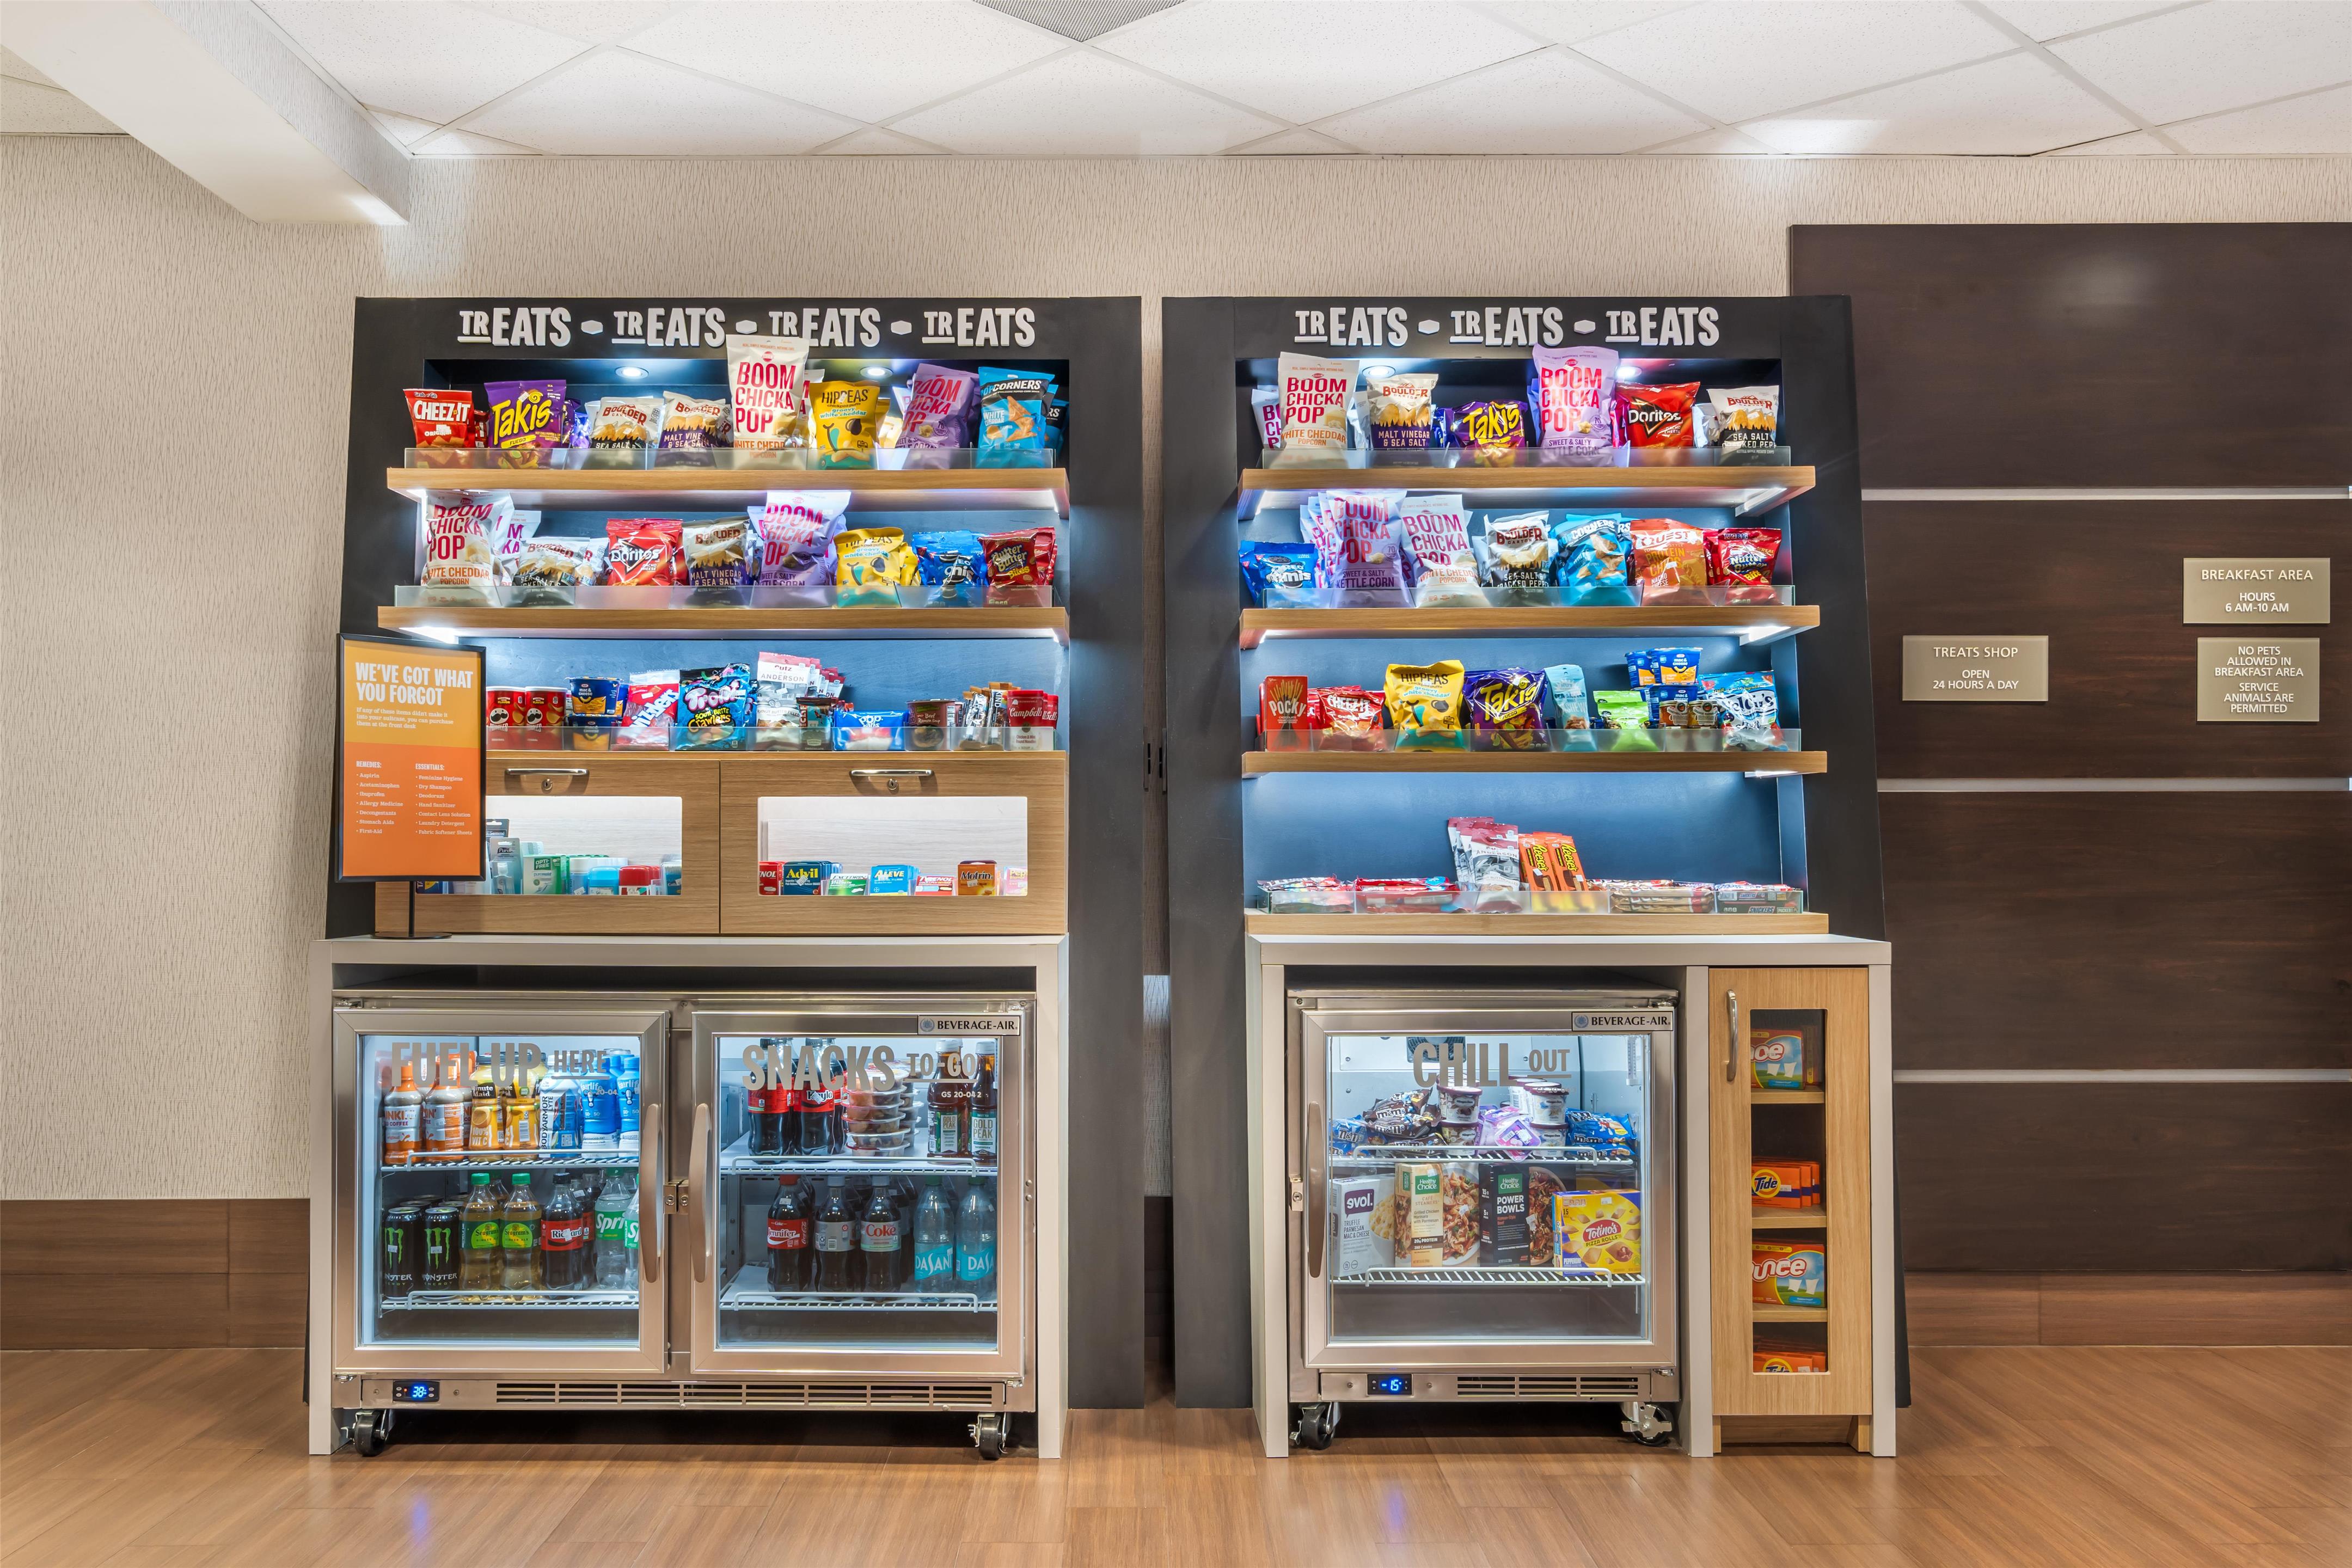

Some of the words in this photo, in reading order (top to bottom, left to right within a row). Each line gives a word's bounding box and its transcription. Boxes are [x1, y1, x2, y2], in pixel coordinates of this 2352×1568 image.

[458, 307, 571, 346] TREATS
[612, 307, 725, 347] TREATS
[769, 308, 881, 347] TREATS
[924, 308, 1035, 347] TREATS
[1295, 307, 1408, 346] TREATS
[1450, 307, 1563, 346] TREATS
[1606, 307, 1719, 346] TREATS
[737, 362, 797, 389] BOOM
[1287, 377, 1346, 393] BOOM
[736, 387, 794, 410] CHICKA
[1287, 393, 1343, 408] CHICKA
[1728, 397, 1772, 410] BOULDER
[736, 408, 773, 433] POP
[983, 410, 1004, 419] WHITE
[1285, 406, 1324, 425] POP
[491, 400, 552, 445] Takis
[984, 417, 1004, 426] CHEDDAR
[510, 437, 526, 445] FUEGO
[1282, 430, 1304, 440] WHITE
[1307, 429, 1346, 444] CHEDDAR
[1402, 431, 1430, 439] VINEGAR
[1334, 496, 1388, 522] BOOM
[1336, 519, 1390, 540] CHICKA
[611, 548, 660, 562] Doritos
[1338, 538, 1372, 565] POP
[449, 567, 489, 580] CHEDDAR
[690, 571, 708, 580] MALT
[712, 570, 741, 579] VINEGAR
[2202, 569, 2274, 580] BREAKFAST
[2278, 570, 2313, 580] AREA
[1336, 577, 1367, 588] KETTLE
[1369, 577, 1394, 587] CORN
[2240, 592, 2275, 601] HOURS
[2226, 603, 2232, 612] 6
[2234, 603, 2268, 612] AM-10
[2271, 603, 2289, 612] AM
[1933, 647, 1979, 658] TREATS
[1984, 647, 2018, 658] SHOP
[2239, 646, 2254, 655] NO
[2258, 647, 2280, 655] PETS
[2227, 657, 2277, 666] ALLOWED
[2281, 657, 2291, 665] IN
[356, 662, 399, 683] WE'VE
[403, 666, 430, 685] GOT
[434, 668, 473, 689] WHAT
[1962, 670, 1989, 678] OPEN
[2215, 667, 2273, 676] BREAKFAST
[2276, 668, 2304, 676] AREA
[1933, 681, 1945, 689] 24
[1949, 681, 1983, 689] HOURS
[1987, 681, 1994, 689] A
[1998, 681, 2019, 689] DAY
[2239, 683, 2278, 691] SERVICE
[356, 682, 385, 702] YOU
[390, 685, 444, 706] FORGOT
[2224, 694, 2270, 702] ANIMALS
[2274, 694, 2294, 702] ARE
[2231, 704, 2287, 713] PERMITTED
[688, 714, 731, 732] Crawlers
[786, 868, 818, 878] Advil
[960, 871, 990, 880] Motrin
[937, 1020, 1016, 1030] BEVERAGE-AIR
[1591, 1016, 1669, 1026] BEVERAGE-AIR
[392, 1042, 477, 1088] FUEL
[491, 1043, 541, 1088] UP
[554, 1050, 607, 1073] HERE
[743, 1045, 895, 1091] SNACKS
[906, 1053, 976, 1077] TO-GO
[1413, 1042, 1517, 1088] CHILL
[1529, 1049, 1570, 1073] OUT
[973, 1119, 993, 1129] GOLD
[473, 1127, 488, 1136] 100%
[973, 1129, 993, 1138] PEAK
[472, 1137, 482, 1145] VIT
[1754, 1176, 1778, 1192] Tide
[1497, 1195, 1524, 1205] POWER
[1497, 1204, 1524, 1214] BOWLS
[768, 1227, 796, 1237] Jennifer
[866, 1224, 896, 1237] Coke
[1585, 1221, 1618, 1240] Totino's
[413, 1387, 425, 1397] 38
